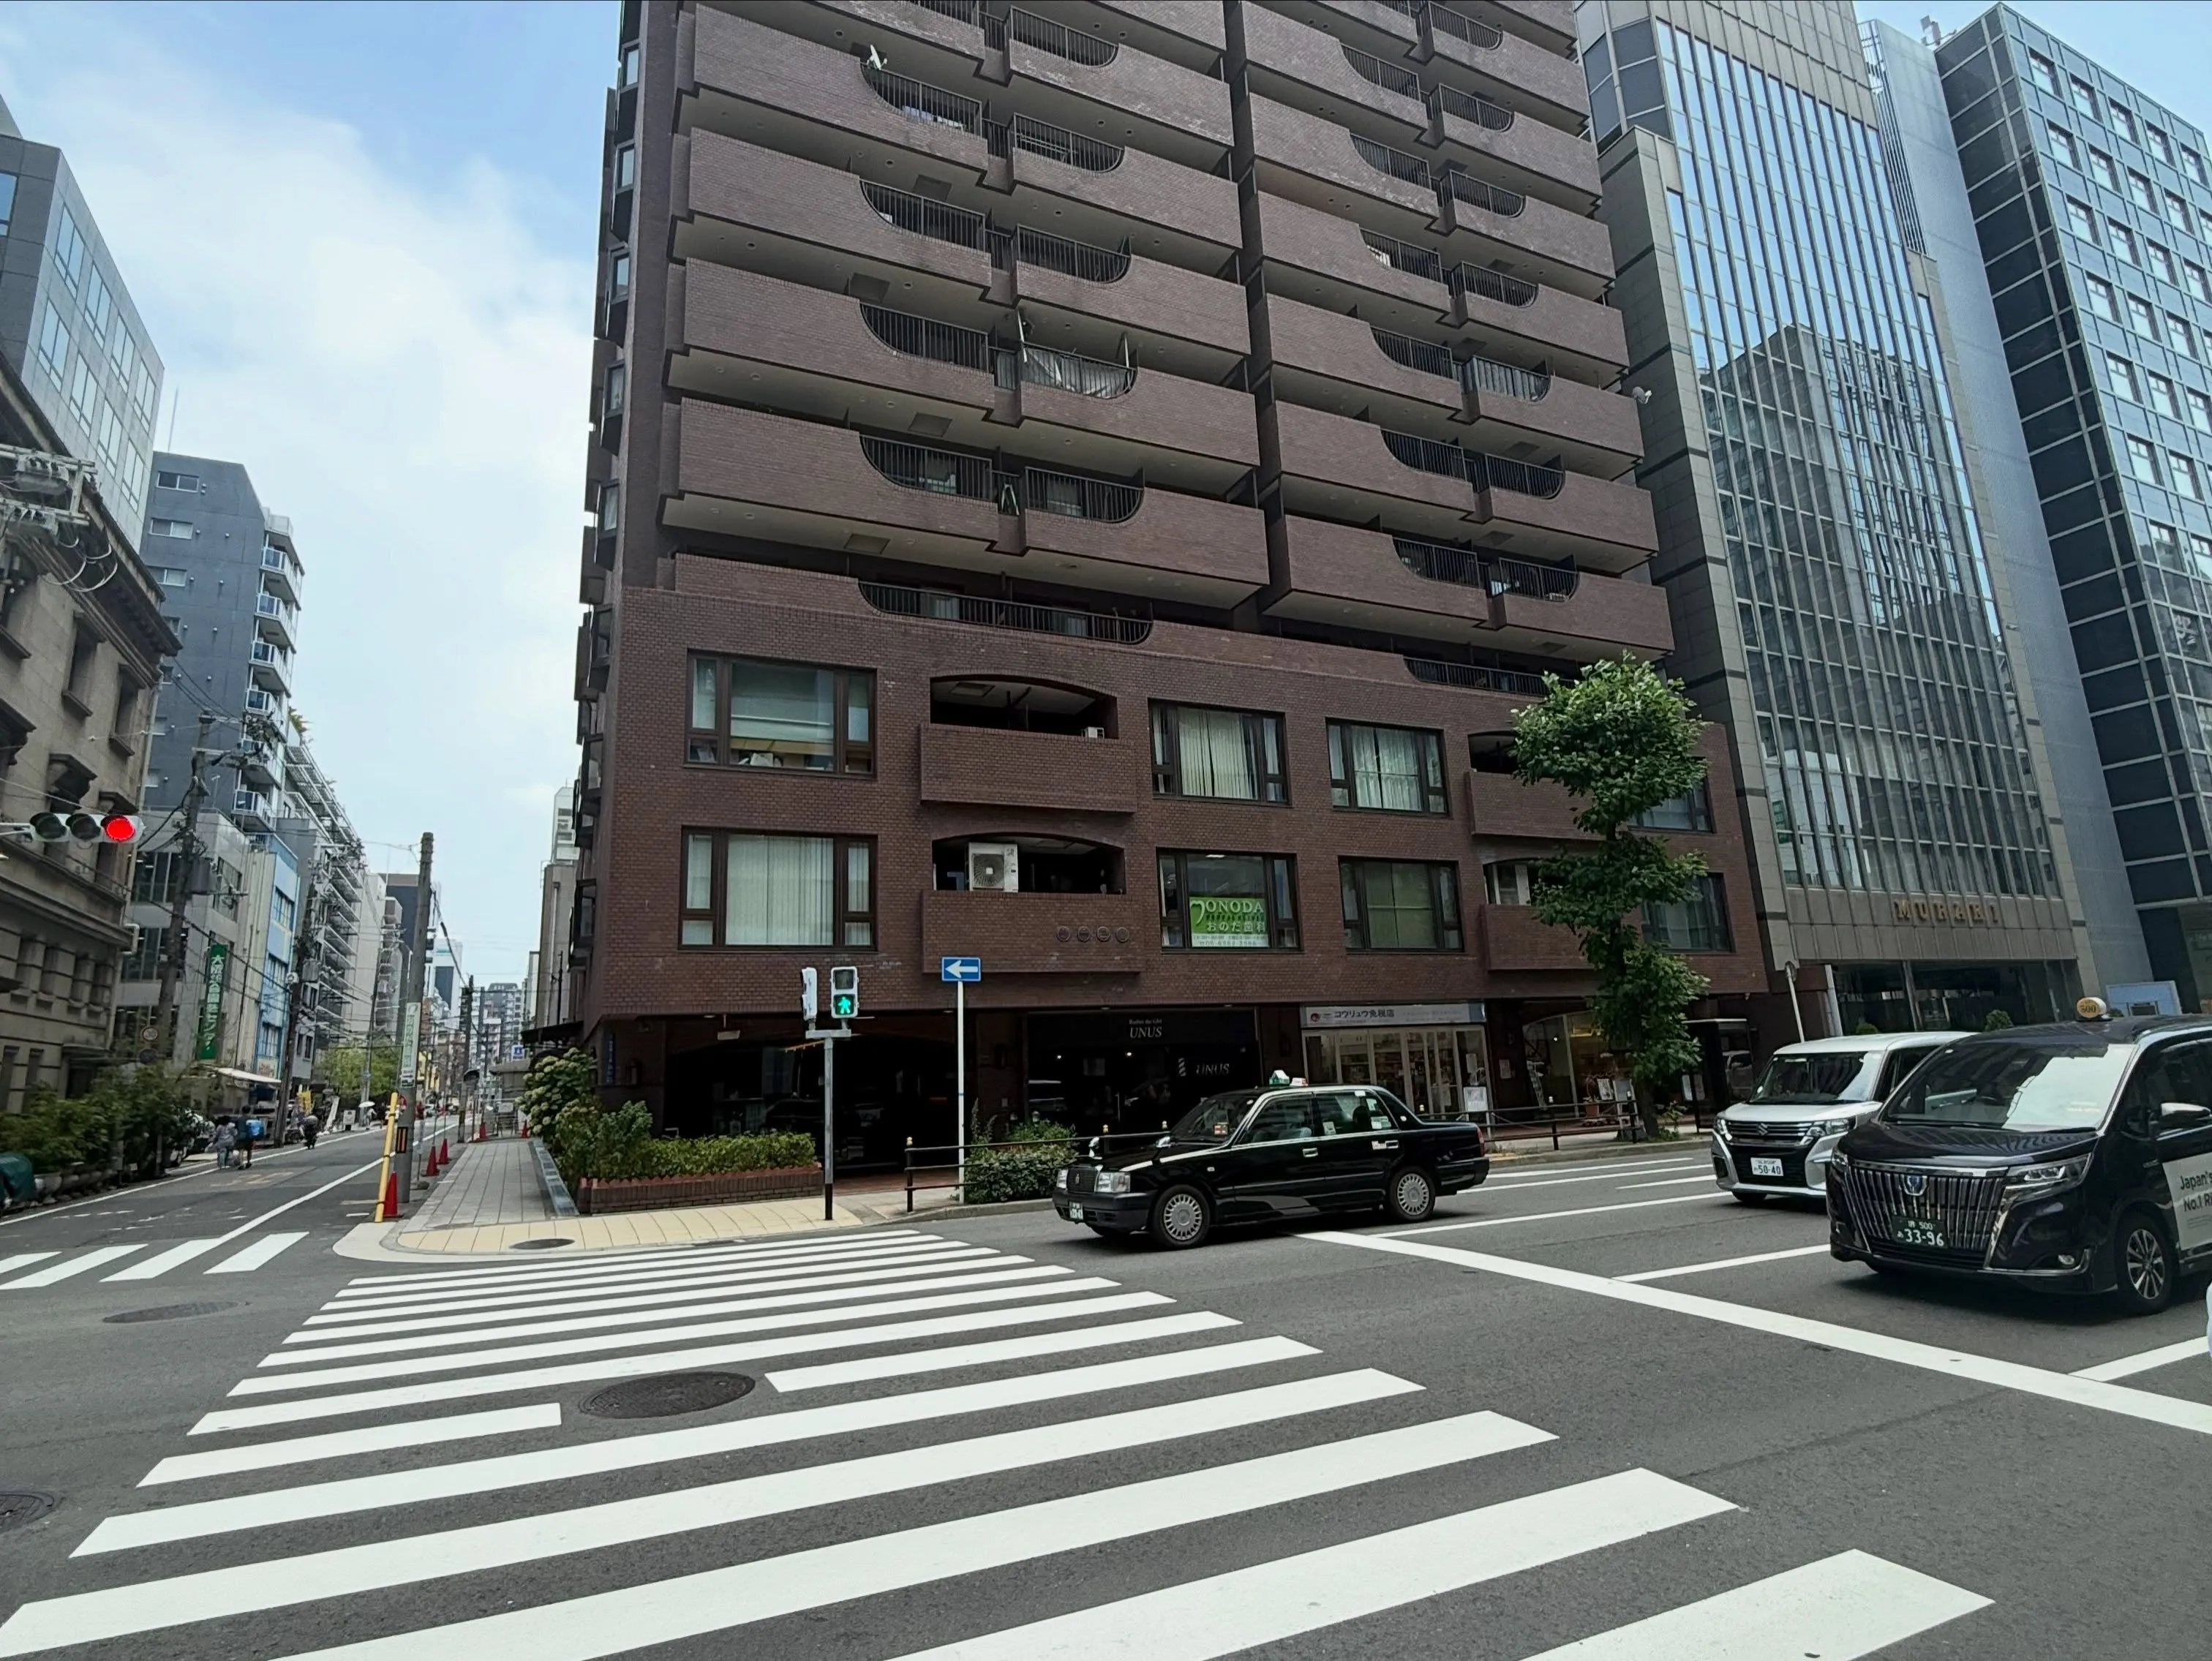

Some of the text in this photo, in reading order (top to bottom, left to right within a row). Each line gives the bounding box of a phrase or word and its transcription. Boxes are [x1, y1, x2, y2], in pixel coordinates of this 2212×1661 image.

[1205, 900, 1264, 913] ONODA
[1894, 900, 1998, 923] MURAKI
[1207, 921, 1265, 933] おのだ歯科
[1333, 1009, 1394, 1018] コウリュウ免税店
[1130, 1026, 1162, 1039] UNUS
[1196, 1063, 1230, 1075] UNUS
[1758, 1164, 1781, 1175] 50-40
[2183, 1194, 2202, 1212] No.1
[1919, 1221, 1933, 1230] 500
[1904, 1228, 1944, 1247] 33-96
